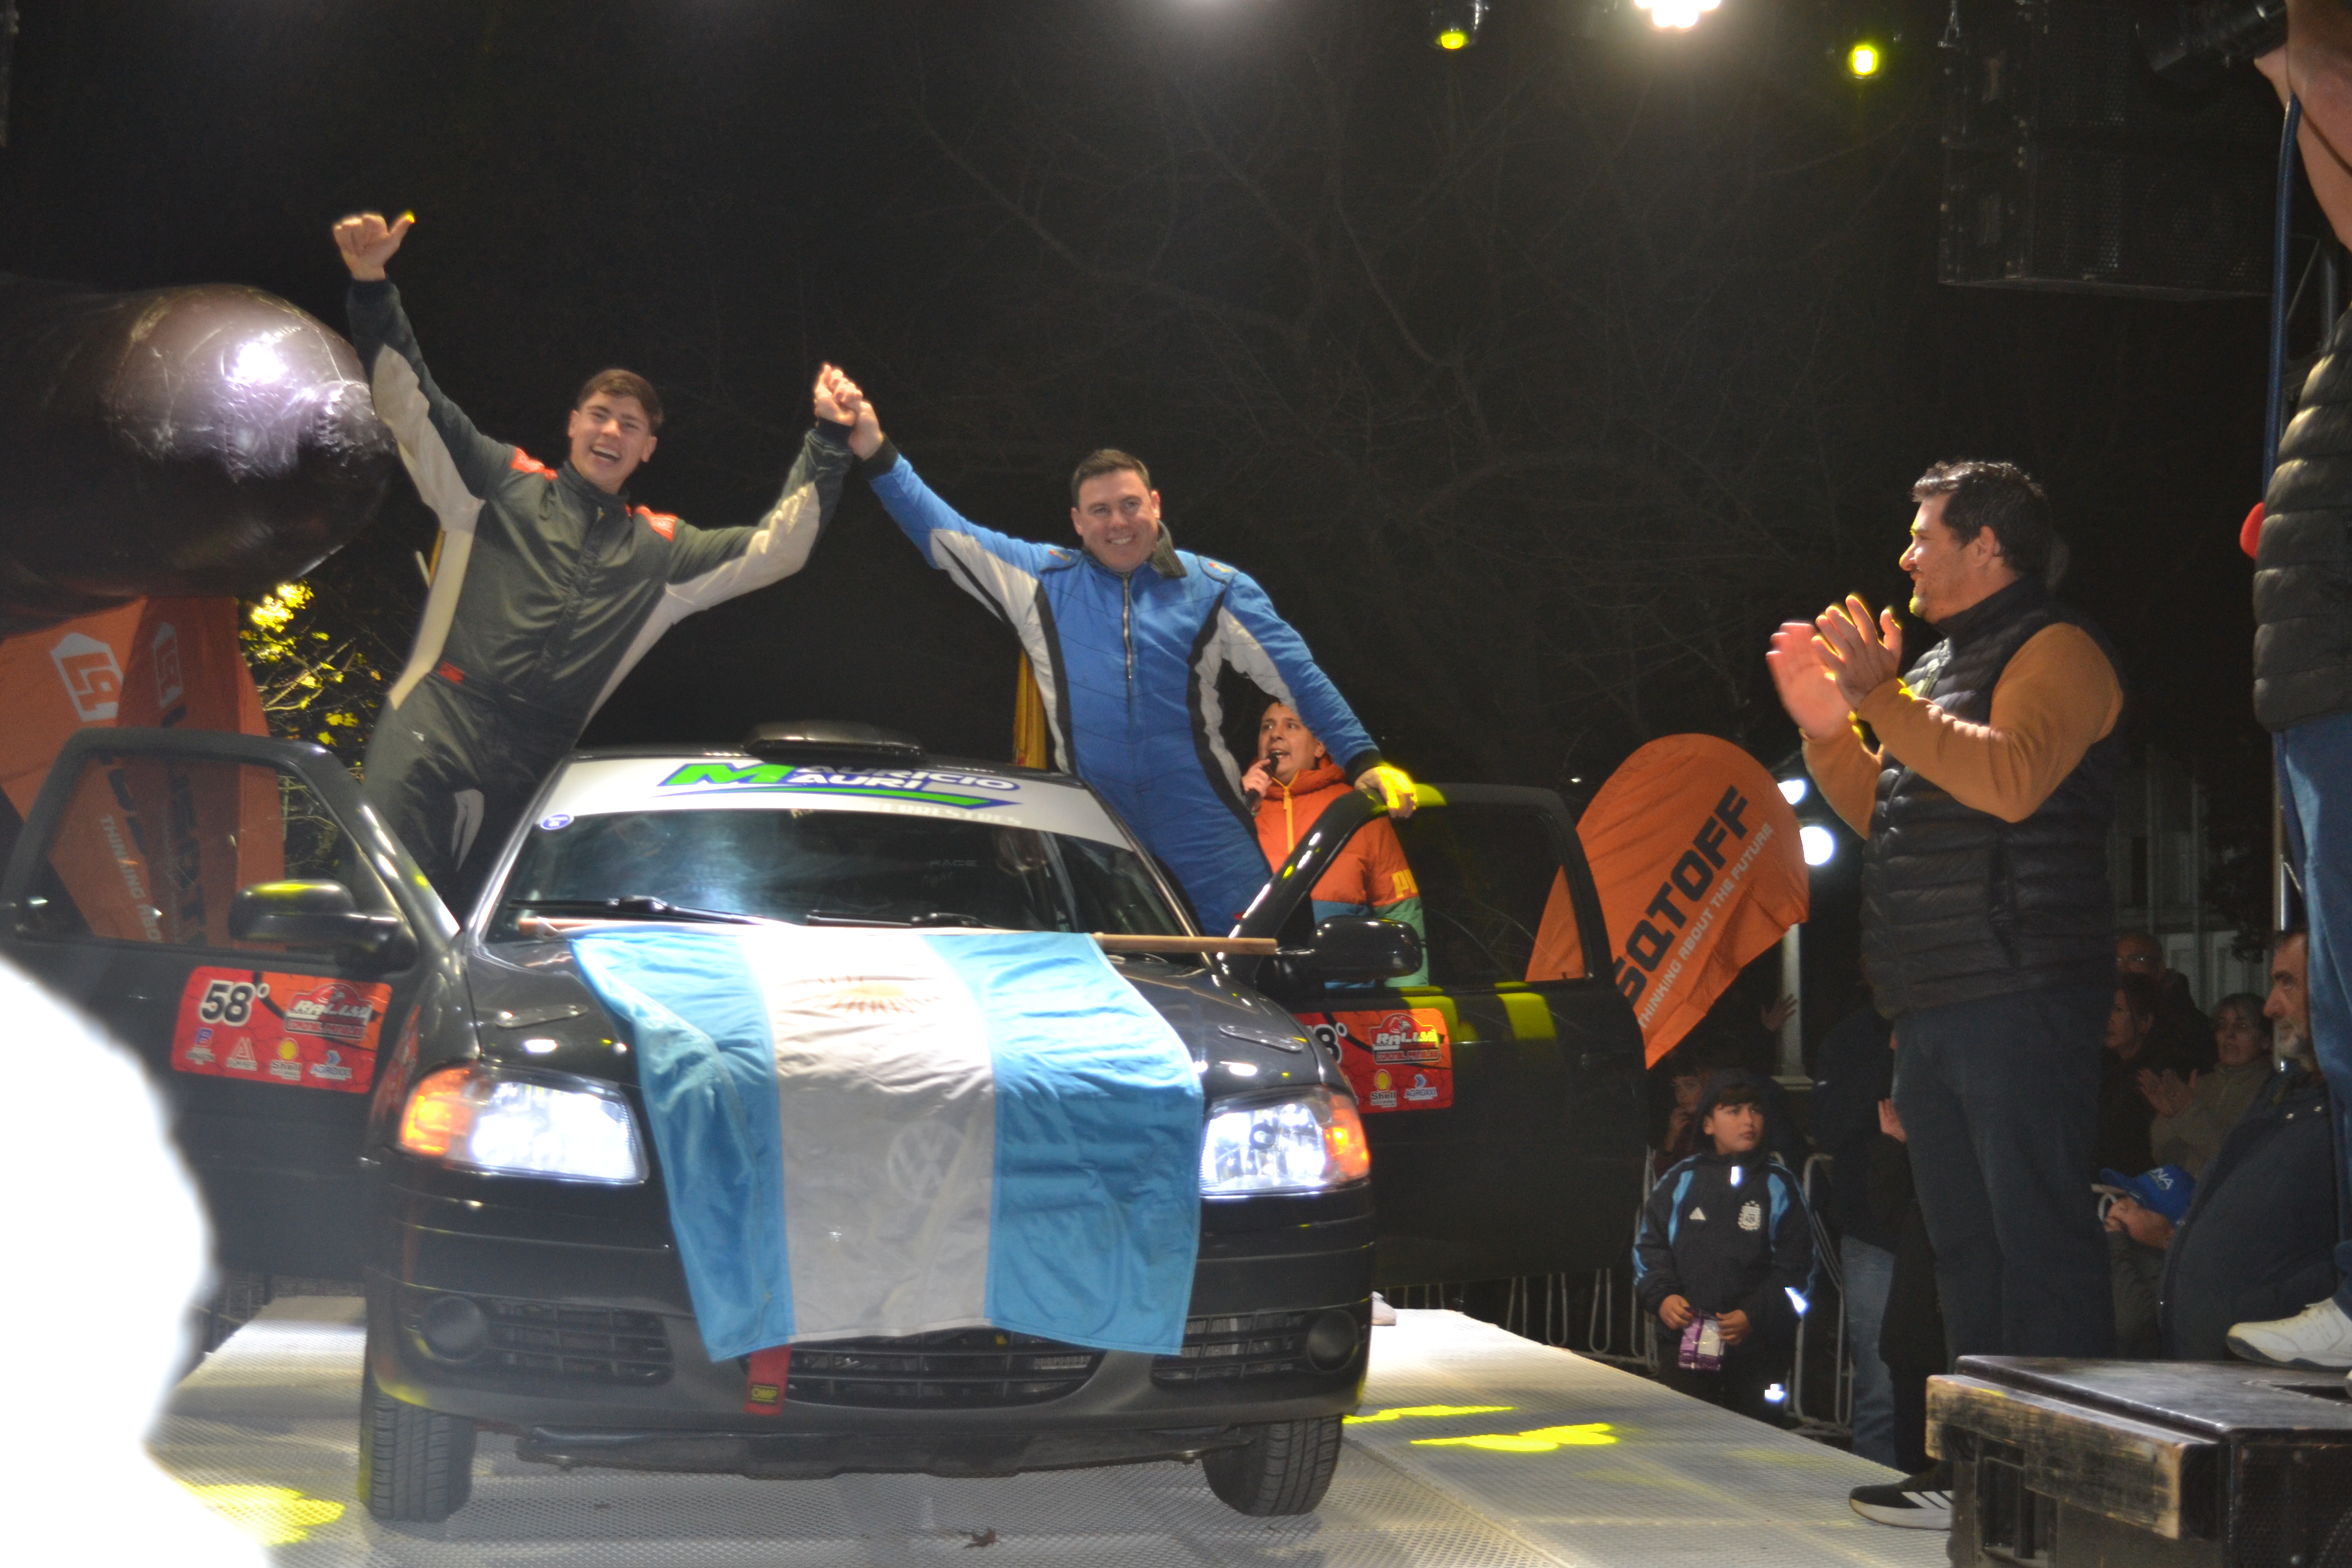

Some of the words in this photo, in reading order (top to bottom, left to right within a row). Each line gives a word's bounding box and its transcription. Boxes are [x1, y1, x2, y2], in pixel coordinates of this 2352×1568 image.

[1638, 959, 1682, 1029] THINKING
[1679, 908, 1714, 963] ABOUT
[1710, 876, 1735, 909] THE
[1732, 822, 1773, 877] FUTURE
[293, 999, 374, 1020] RALLY
[1377, 1028, 1438, 1046] RALLY
[272, 1061, 301, 1072] Shell
[1371, 1092, 1396, 1100] Shell
